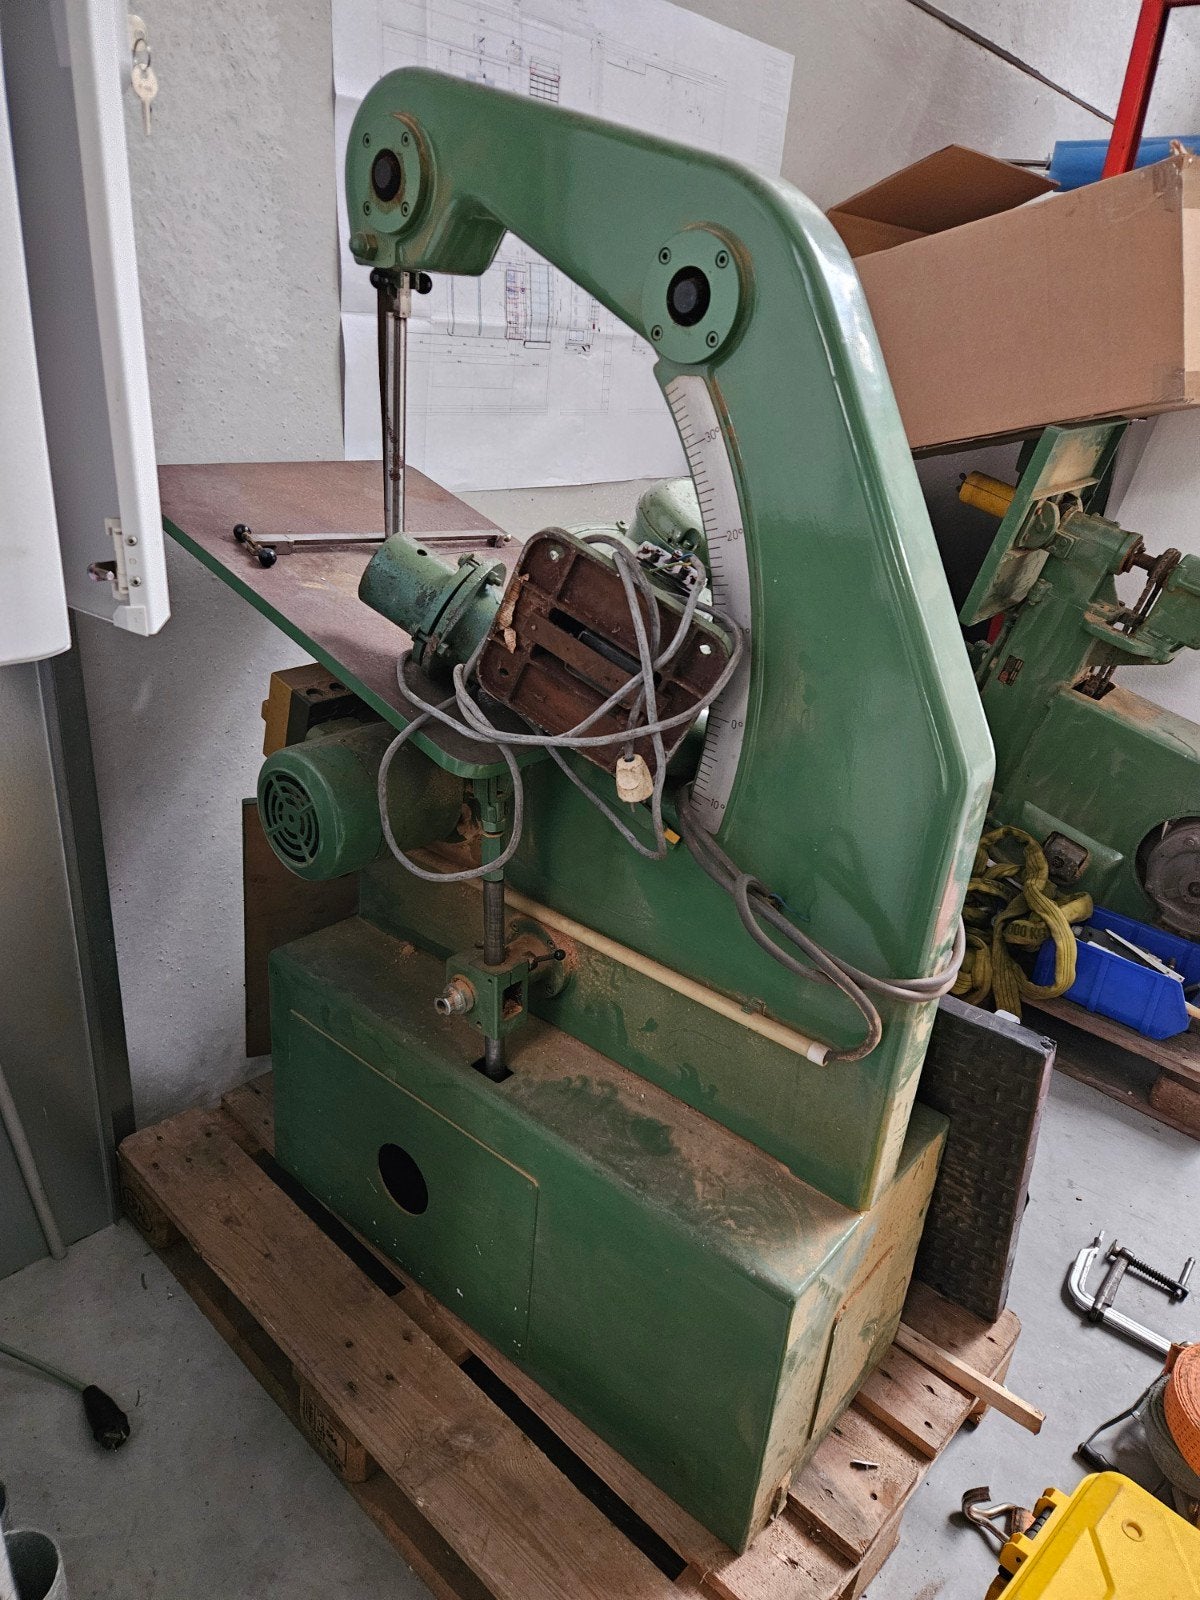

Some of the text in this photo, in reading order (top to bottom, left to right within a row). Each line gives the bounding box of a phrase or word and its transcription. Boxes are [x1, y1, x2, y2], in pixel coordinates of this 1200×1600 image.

[704, 426, 720, 443] 30°
[726, 527, 743, 541] 20°
[731, 719, 743, 730] 0°
